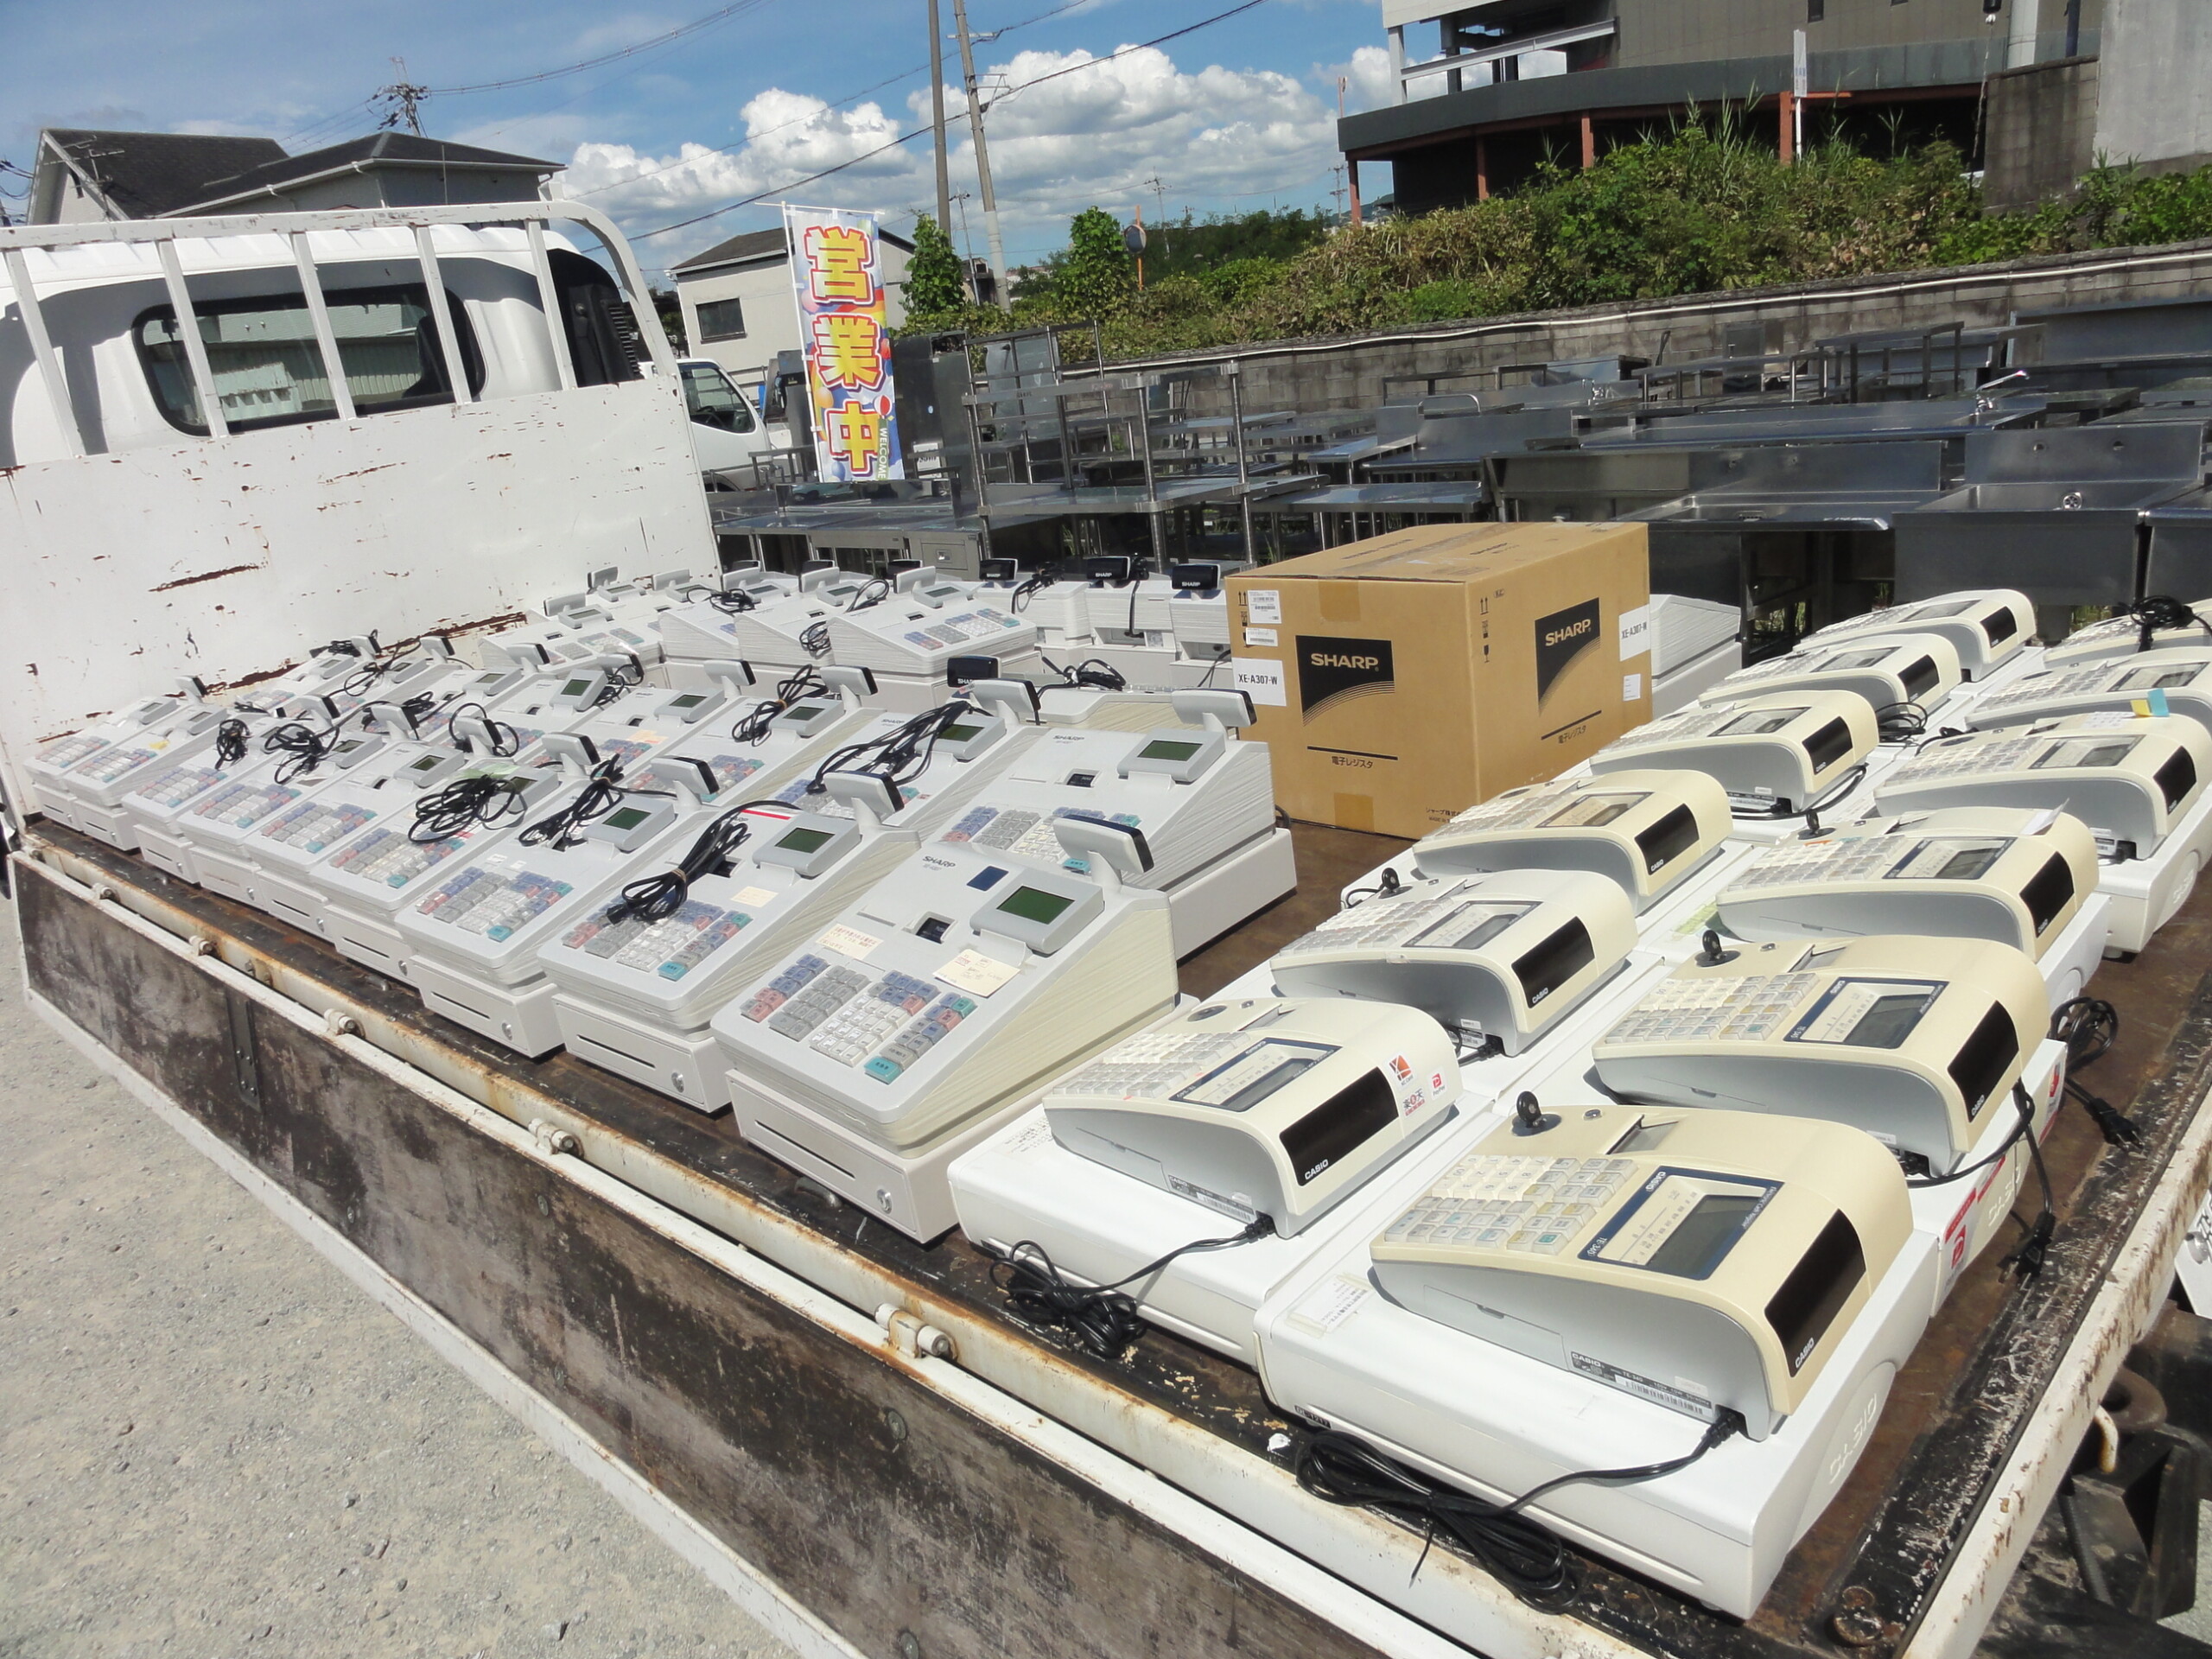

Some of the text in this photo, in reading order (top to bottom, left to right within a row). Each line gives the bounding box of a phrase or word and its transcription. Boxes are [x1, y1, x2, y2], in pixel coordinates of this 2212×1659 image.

[804, 226, 885, 474] 営業中
[877, 428, 888, 479] WELCOME
[1545, 619, 1592, 646] SHARP
[1311, 652, 1379, 670] SHARP
[1238, 674, 1278, 685] XE-A307-W
[1331, 755, 1374, 769] 電子レジスタ
[922, 855, 956, 868] SHARP
[1532, 987, 1548, 1003] CASIO
[1304, 1159, 1329, 1180] CASIO
[1572, 1353, 1601, 1368] CASIO
[1795, 1337, 1815, 1369] CASIO
